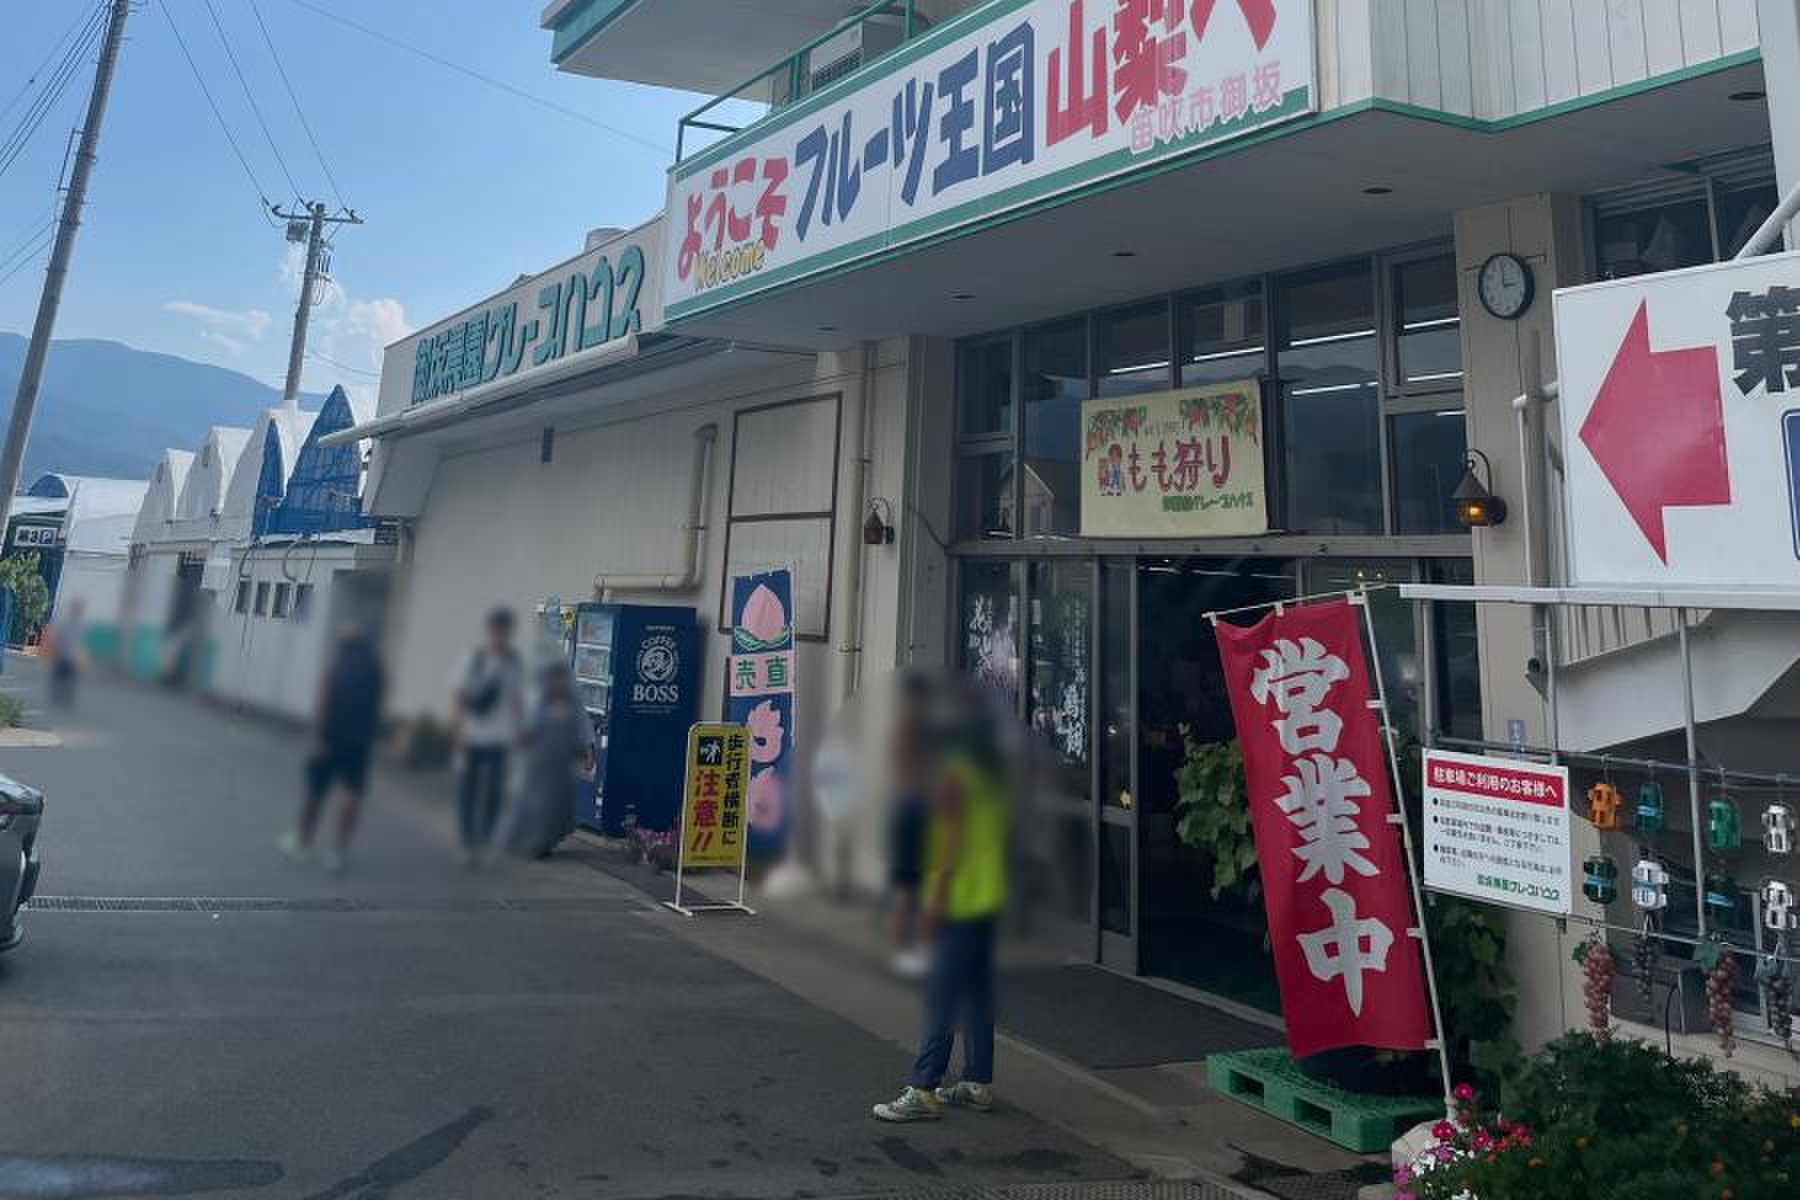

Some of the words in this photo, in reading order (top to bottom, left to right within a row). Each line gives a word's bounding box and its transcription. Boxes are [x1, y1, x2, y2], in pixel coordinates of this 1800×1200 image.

[694, 240, 766, 291] Welcome
[1128, 435, 1231, 492] もも狩り
[634, 684, 678, 702] BOSS
[1251, 637, 1395, 1018] 営業中
